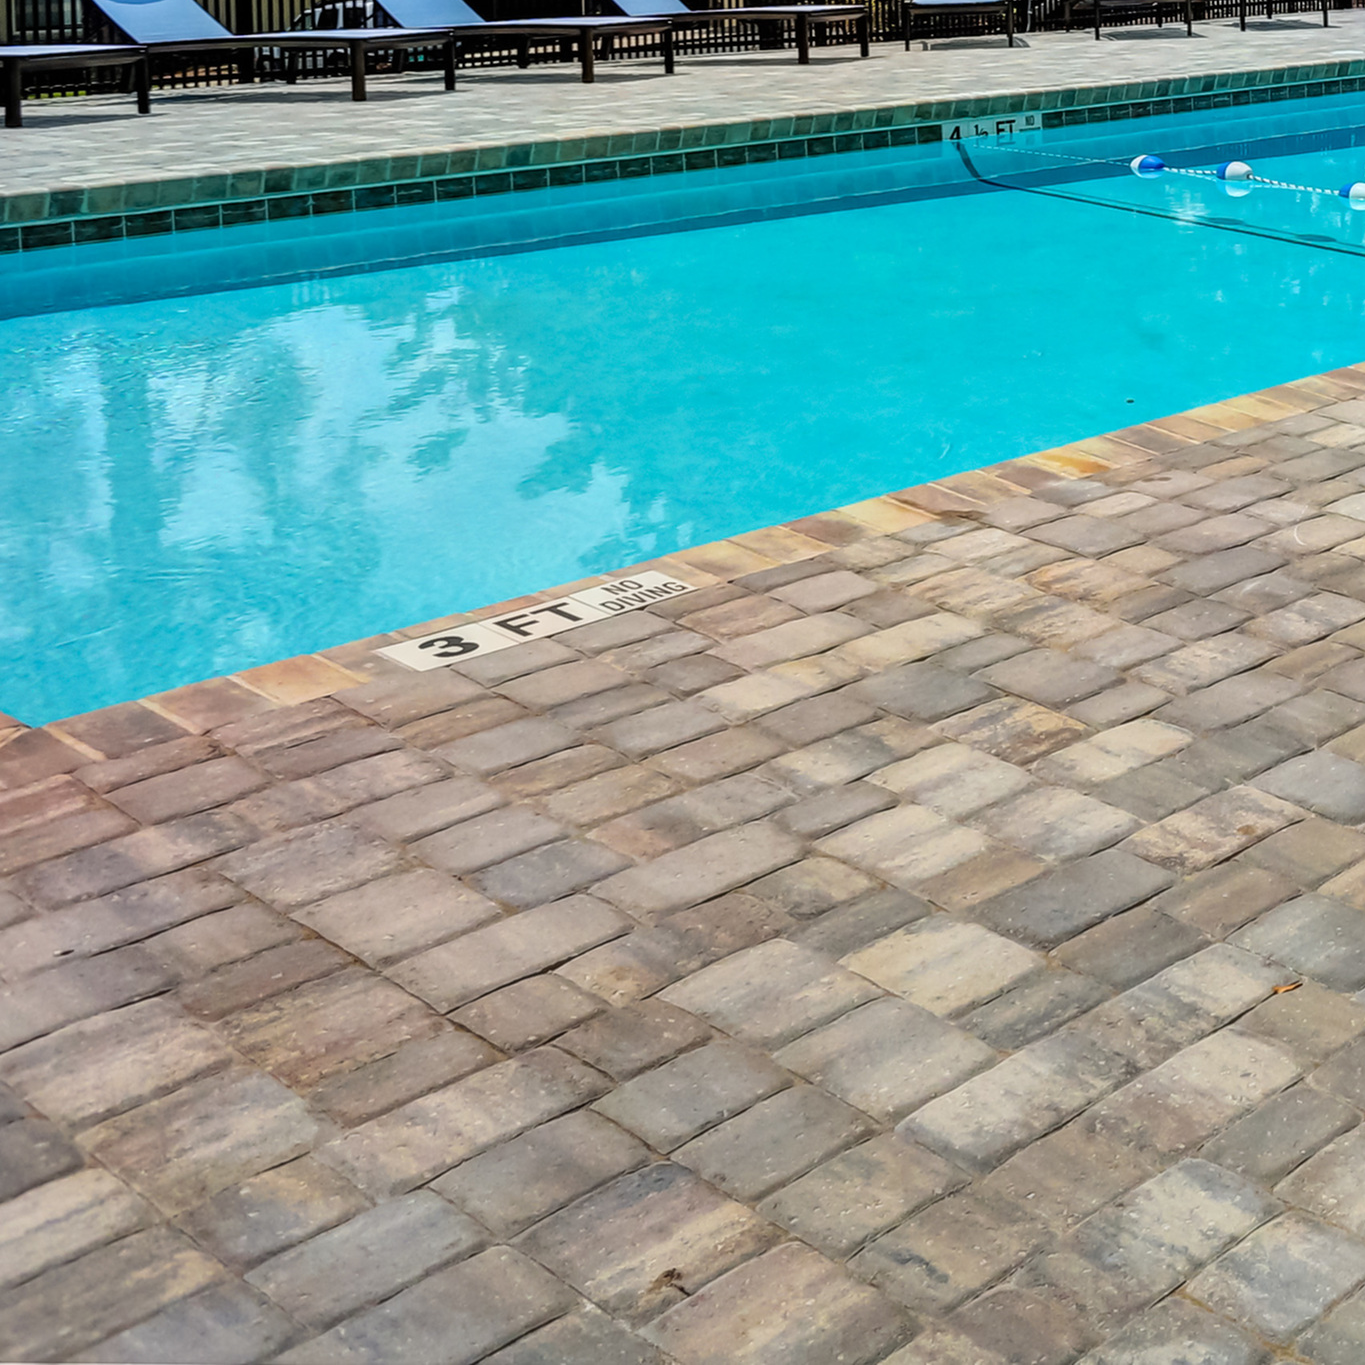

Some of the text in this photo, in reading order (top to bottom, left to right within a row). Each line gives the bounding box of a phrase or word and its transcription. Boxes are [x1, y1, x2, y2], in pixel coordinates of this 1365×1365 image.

[996, 120, 1016, 135] FT
[599, 581, 689, 612] DIVING
[601, 579, 644, 596] NO
[418, 602, 584, 658] 3 FT
